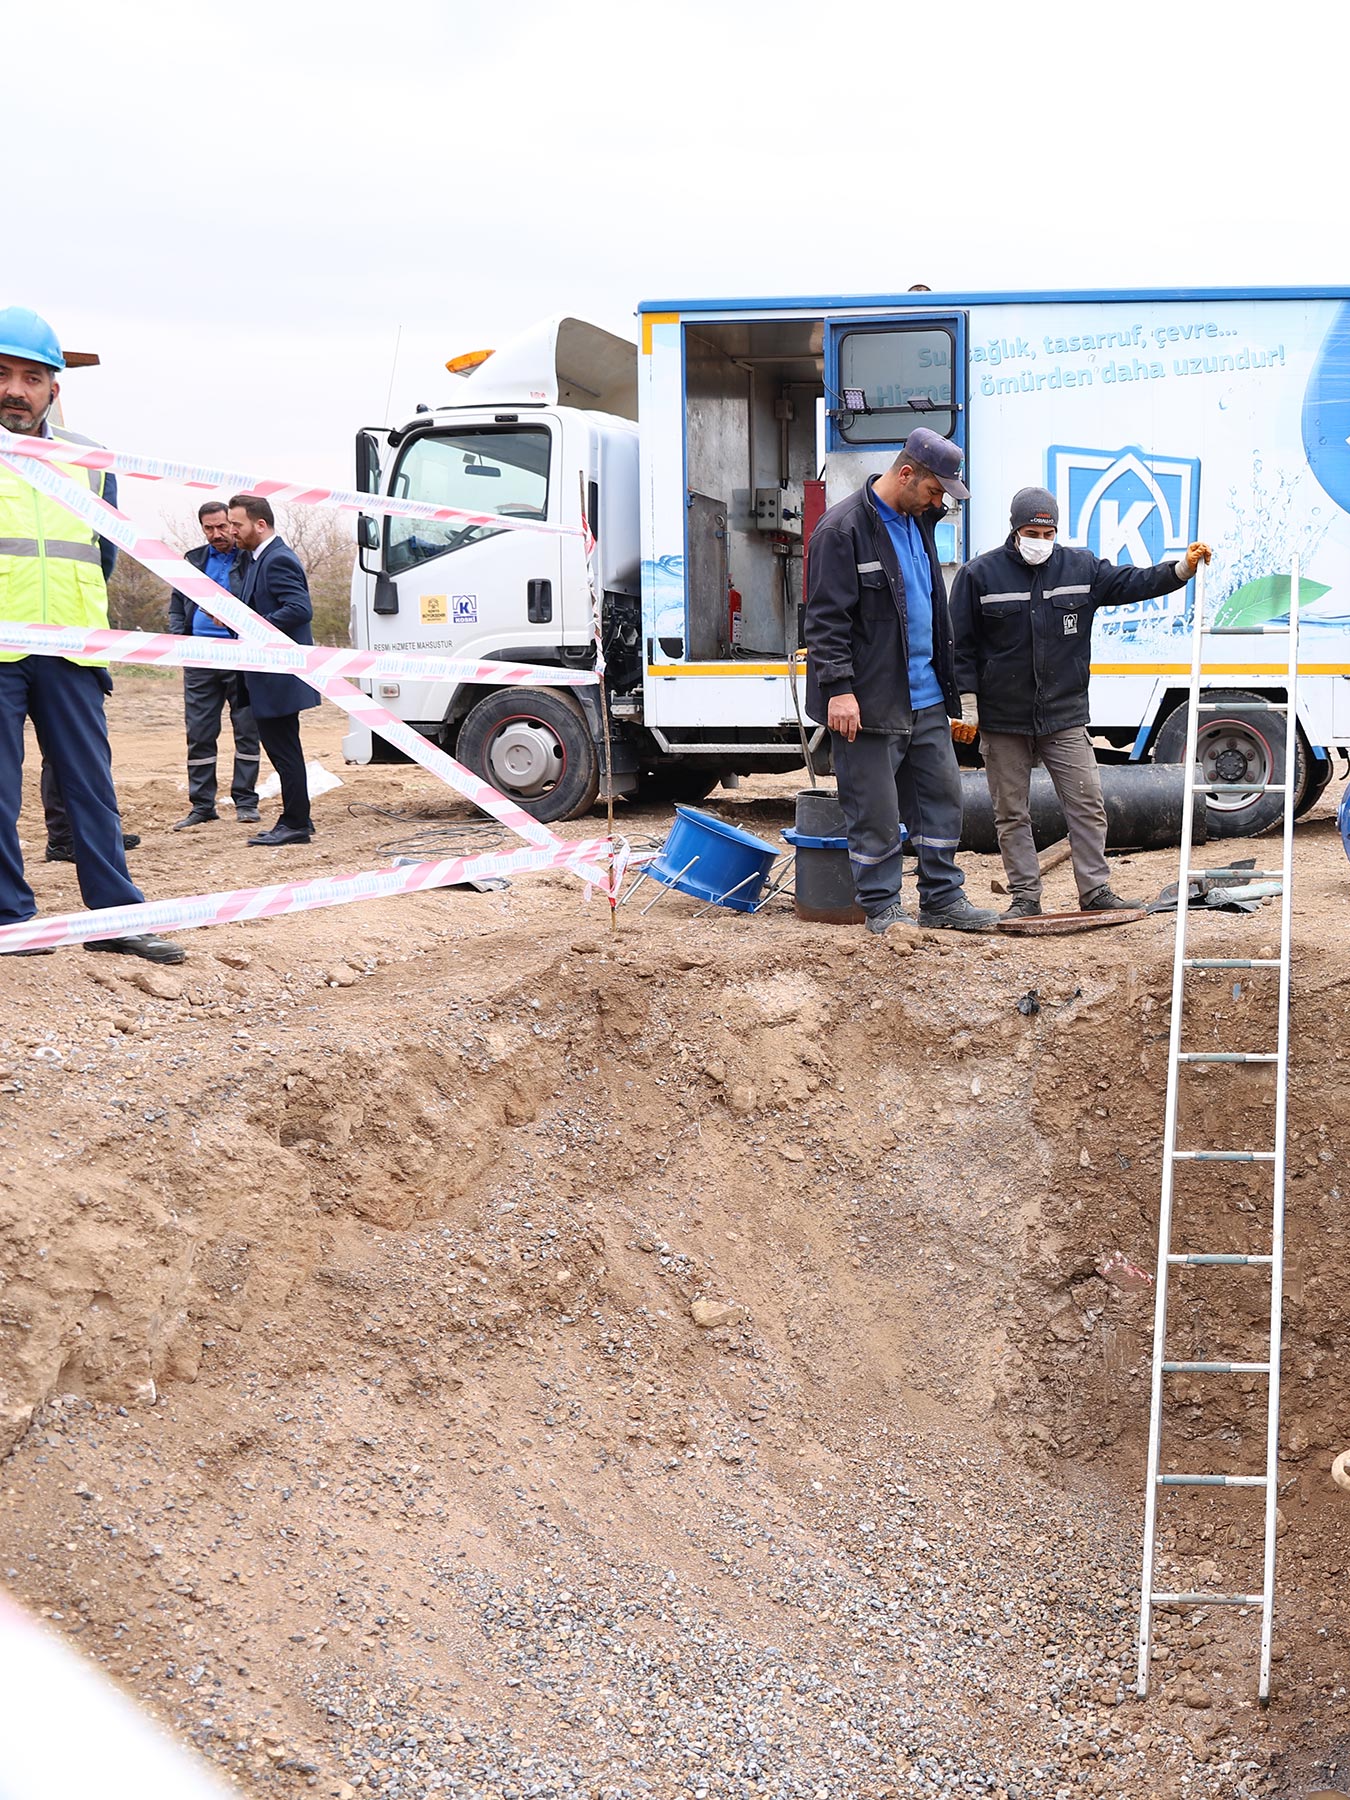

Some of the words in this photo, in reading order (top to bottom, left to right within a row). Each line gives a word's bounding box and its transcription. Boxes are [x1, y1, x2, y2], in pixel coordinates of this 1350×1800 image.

[1043, 322, 1147, 356] tasarruf,
[1153, 319, 1238, 349] çevre...
[980, 369, 1093, 397] ömürden
[1100, 359, 1166, 384] daha
[1173, 343, 1286, 376] uzundur!
[1100, 499, 1157, 568] K
